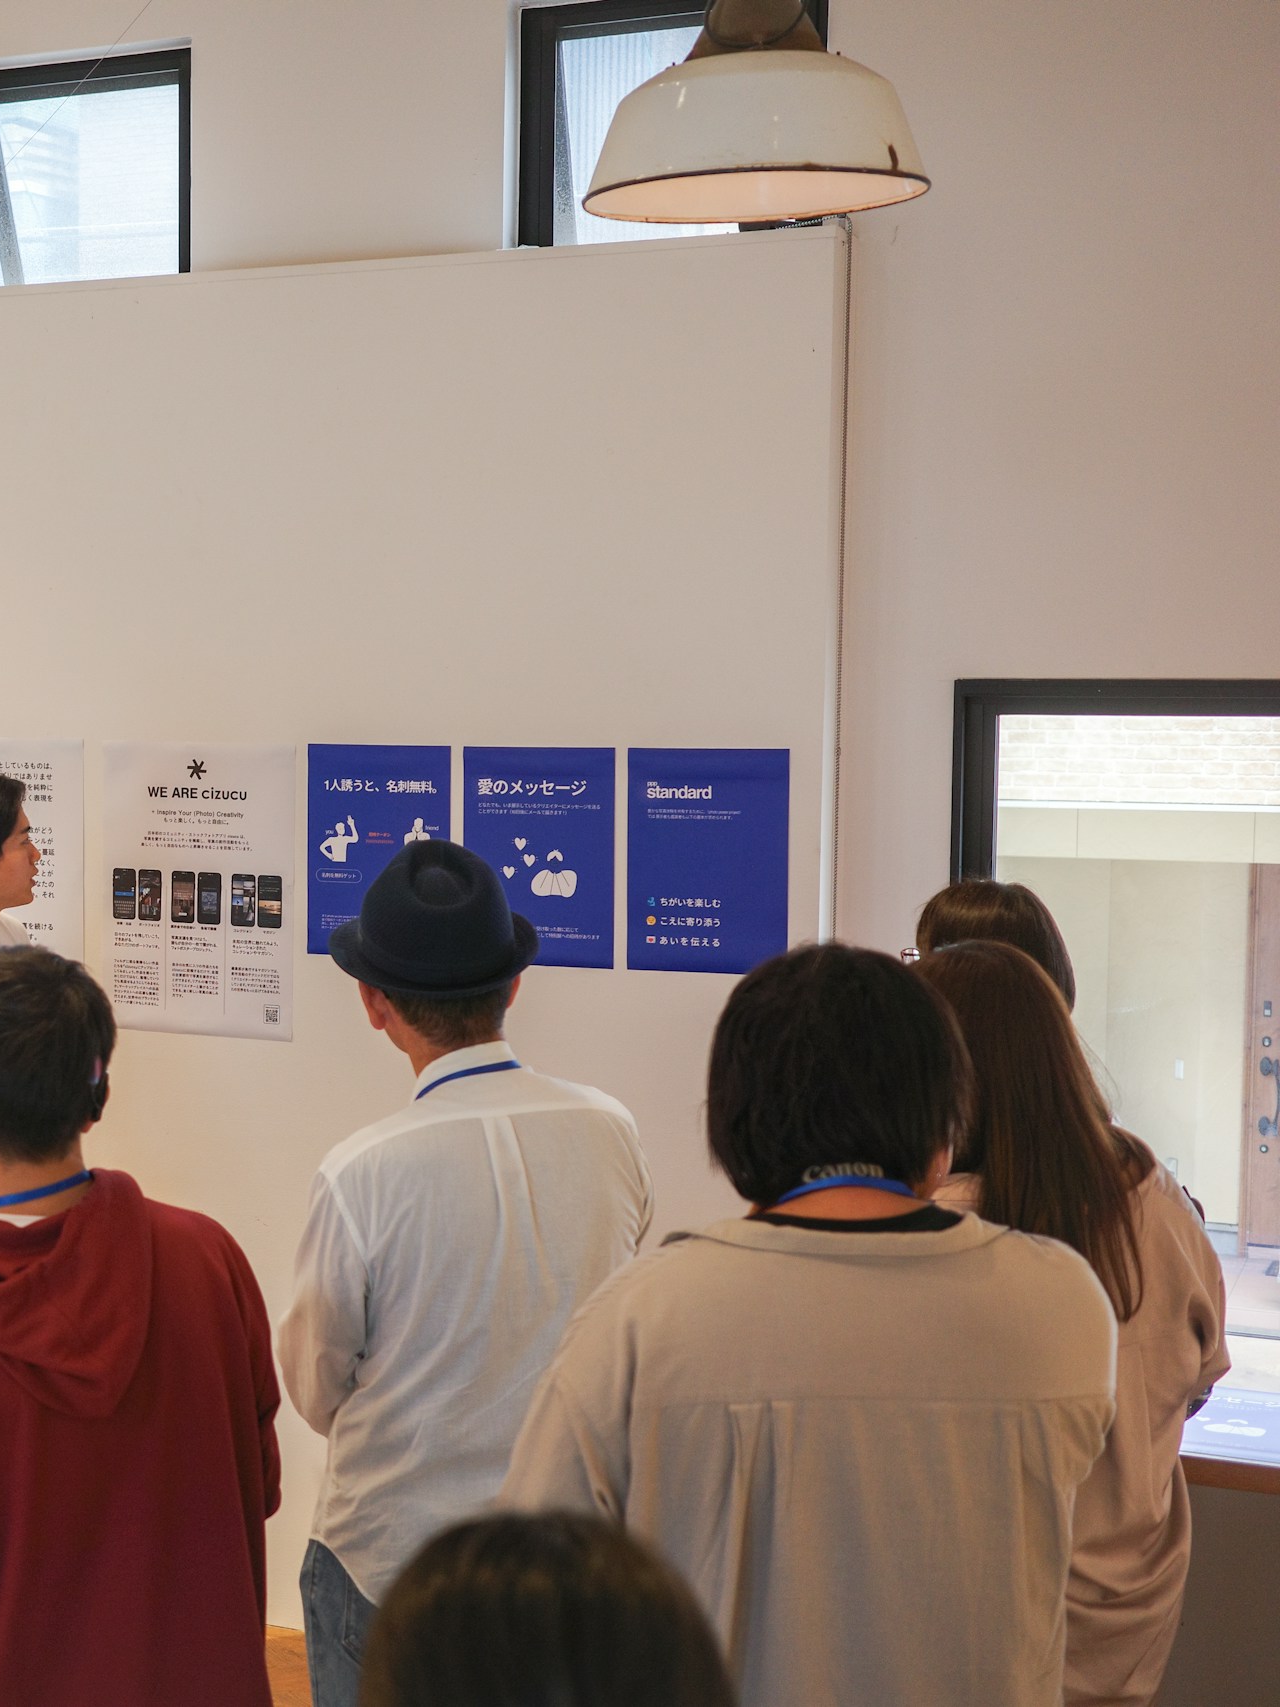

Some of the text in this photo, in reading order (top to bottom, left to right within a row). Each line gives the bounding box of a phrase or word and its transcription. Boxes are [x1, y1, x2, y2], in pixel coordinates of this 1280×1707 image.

[24, 783, 53, 791] を純粋に
[324, 779, 437, 794] 1人誘うと、名刺無料。
[477, 778, 587, 796] 愛のメッセージ
[646, 785, 712, 800] standard
[147, 786, 247, 801] WE ARE cizucu
[156, 809, 244, 819] Inspire Your (Photo) Creativity
[660, 897, 721, 908] ちがいを楽しむ
[660, 917, 721, 928] こえに寄り添う
[659, 936, 721, 947] あいを伝える
[802, 1162, 884, 1183] Canon
